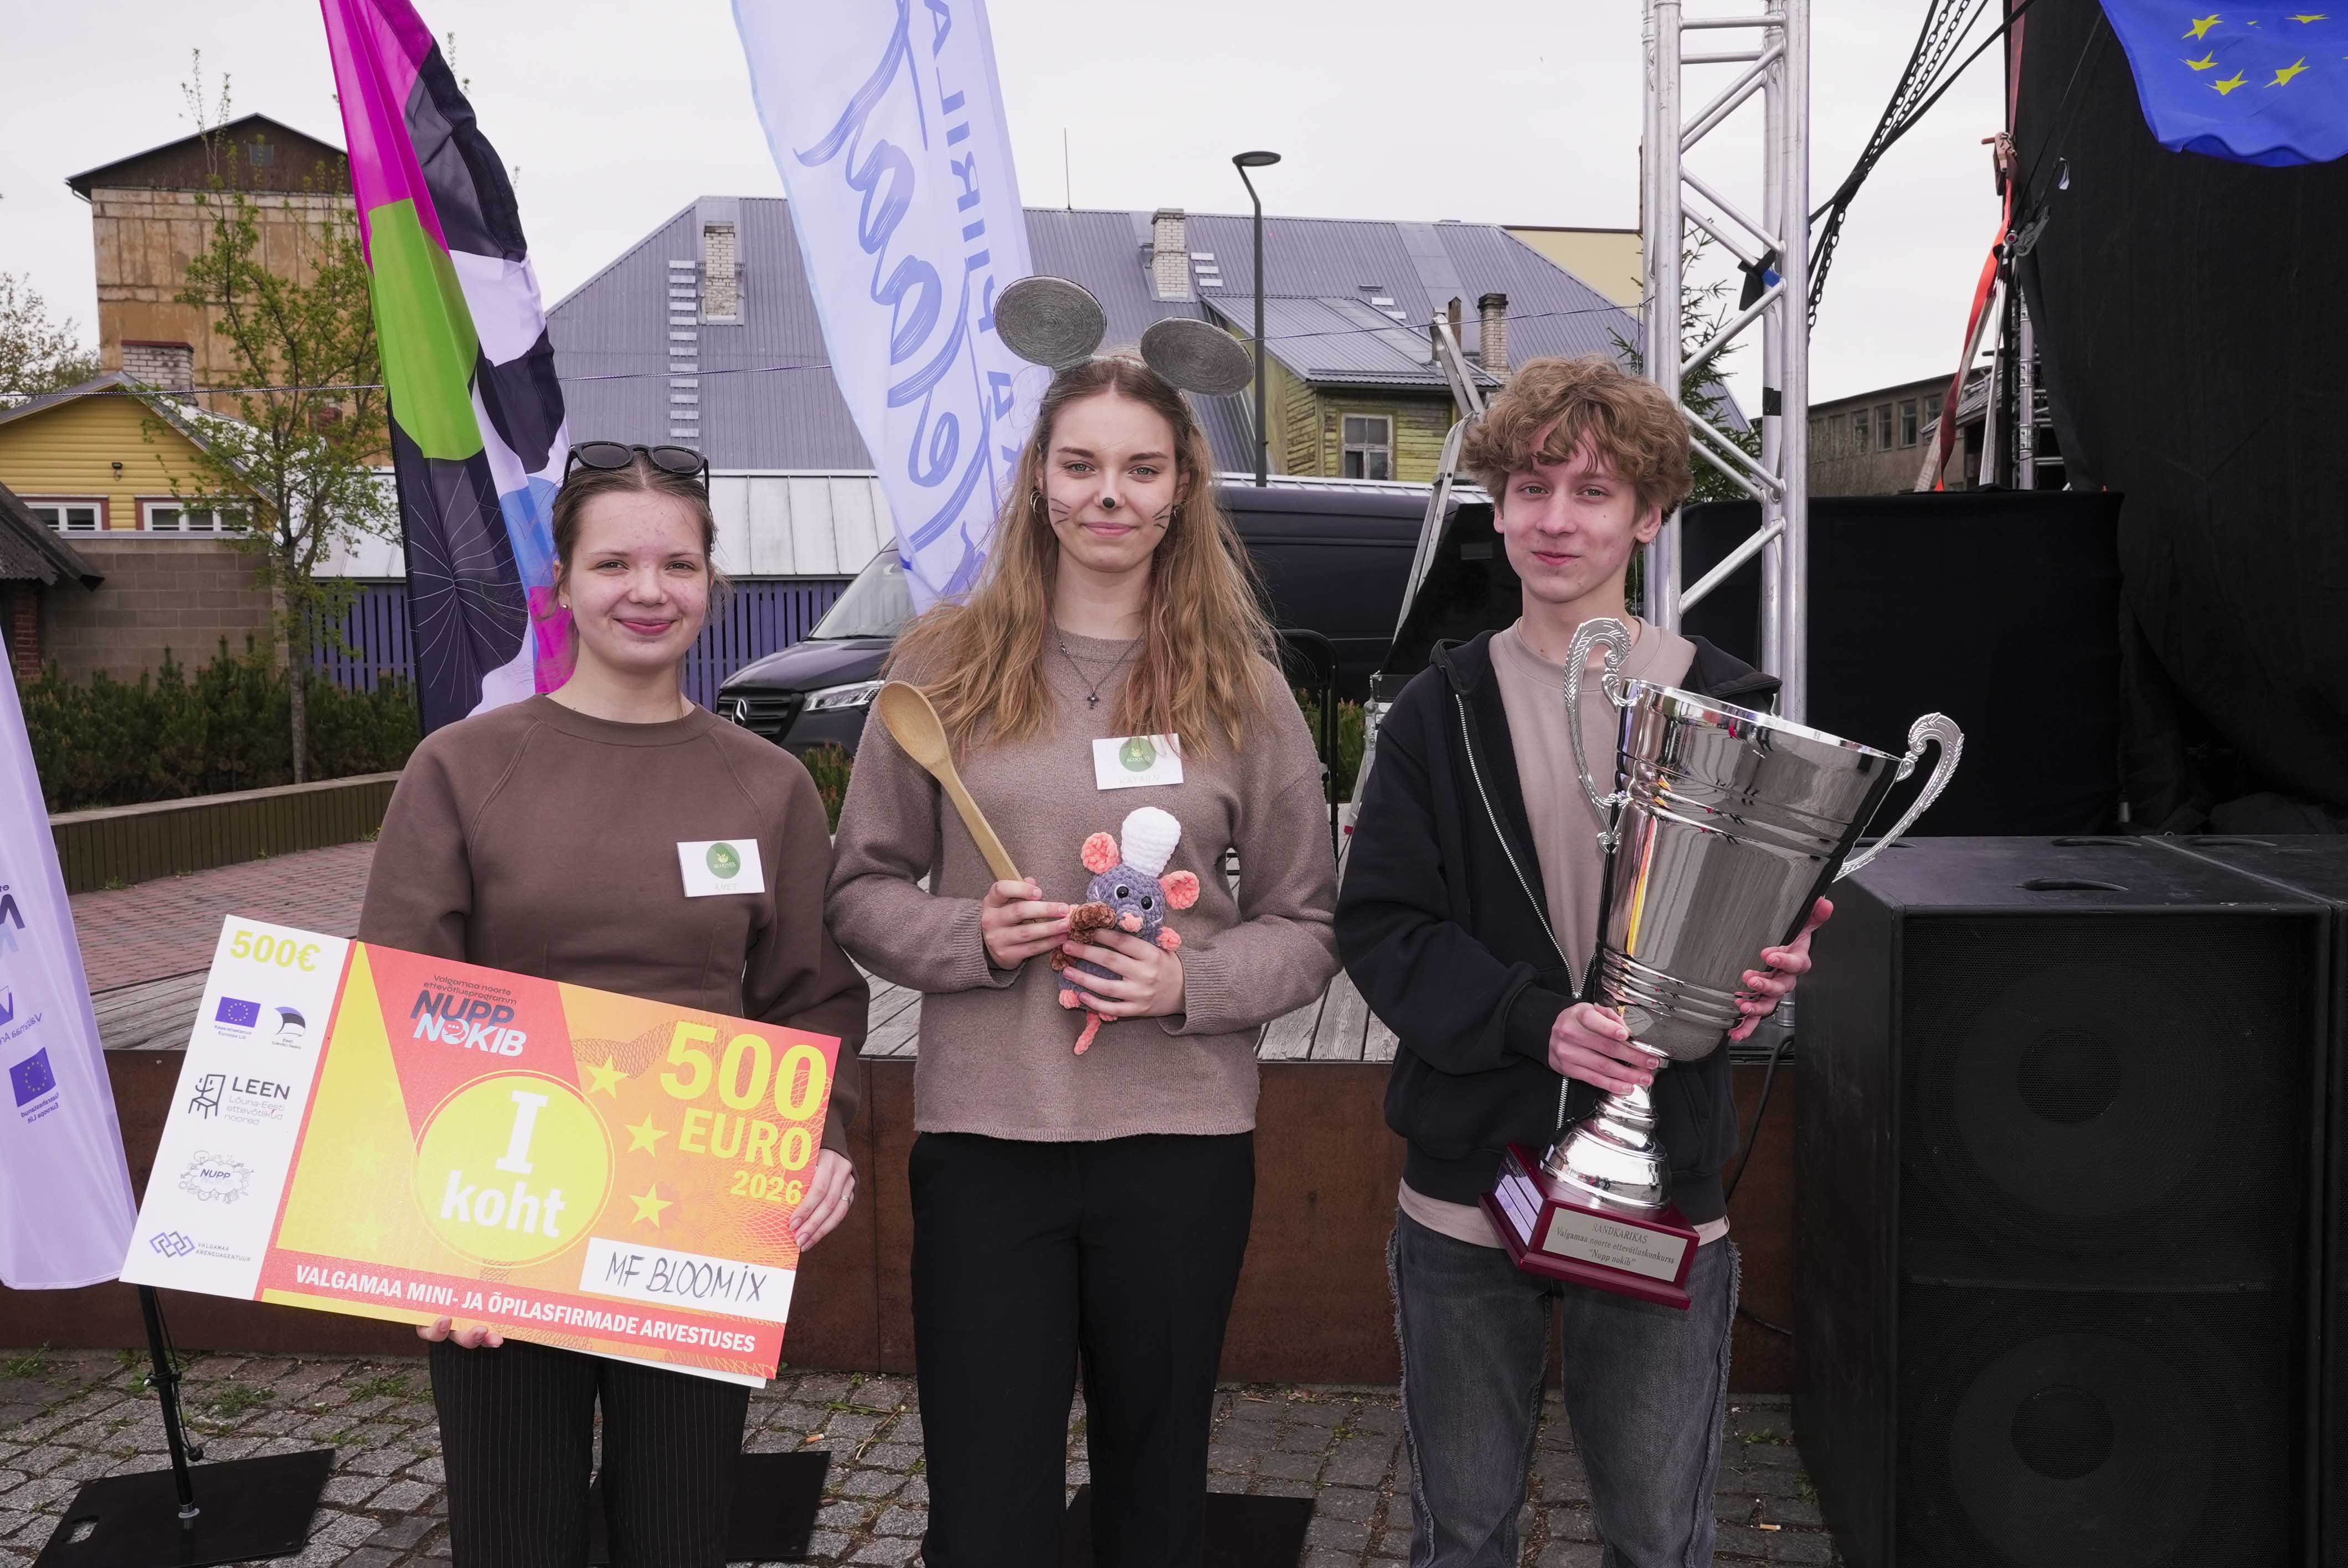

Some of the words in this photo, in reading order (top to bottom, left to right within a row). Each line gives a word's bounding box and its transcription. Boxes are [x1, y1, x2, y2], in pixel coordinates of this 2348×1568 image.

[230, 930, 321, 972] 500€
[424, 981, 517, 1005] ettevõtlusprogramm
[434, 974, 480, 989] Valgamaa
[482, 984, 511, 996] noorte
[410, 990, 514, 1027] NUPP
[413, 1013, 527, 1057] NOKIB
[232, 1076, 291, 1100] LEEN
[660, 1021, 827, 1121] 500
[224, 1114, 260, 1125] noored
[226, 1105, 284, 1121] ettevõtlikud
[229, 1095, 285, 1111] Lõuna-Eesti
[495, 1090, 548, 1175] I
[678, 1108, 812, 1171] EURO
[200, 1169, 231, 1179] NUPP
[730, 1171, 803, 1205] 2026
[440, 1169, 566, 1238] koht
[195, 1249, 251, 1262] ARENGUAGENTUUR
[198, 1242, 229, 1251] VALGAMAA
[1557, 1226, 1588, 1241] Valgamaa
[1589, 1238, 1611, 1249] noorte
[1613, 1242, 1675, 1264] ettevõtluskonkurss
[605, 1251, 645, 1288] MF
[296, 1265, 402, 1298] VALGAMAA
[406, 1283, 459, 1306] MINI-
[461, 1291, 483, 1311] JA
[488, 1291, 639, 1334] ÕPILASFIRMADE
[640, 1319, 755, 1353] ARVESTUSES
